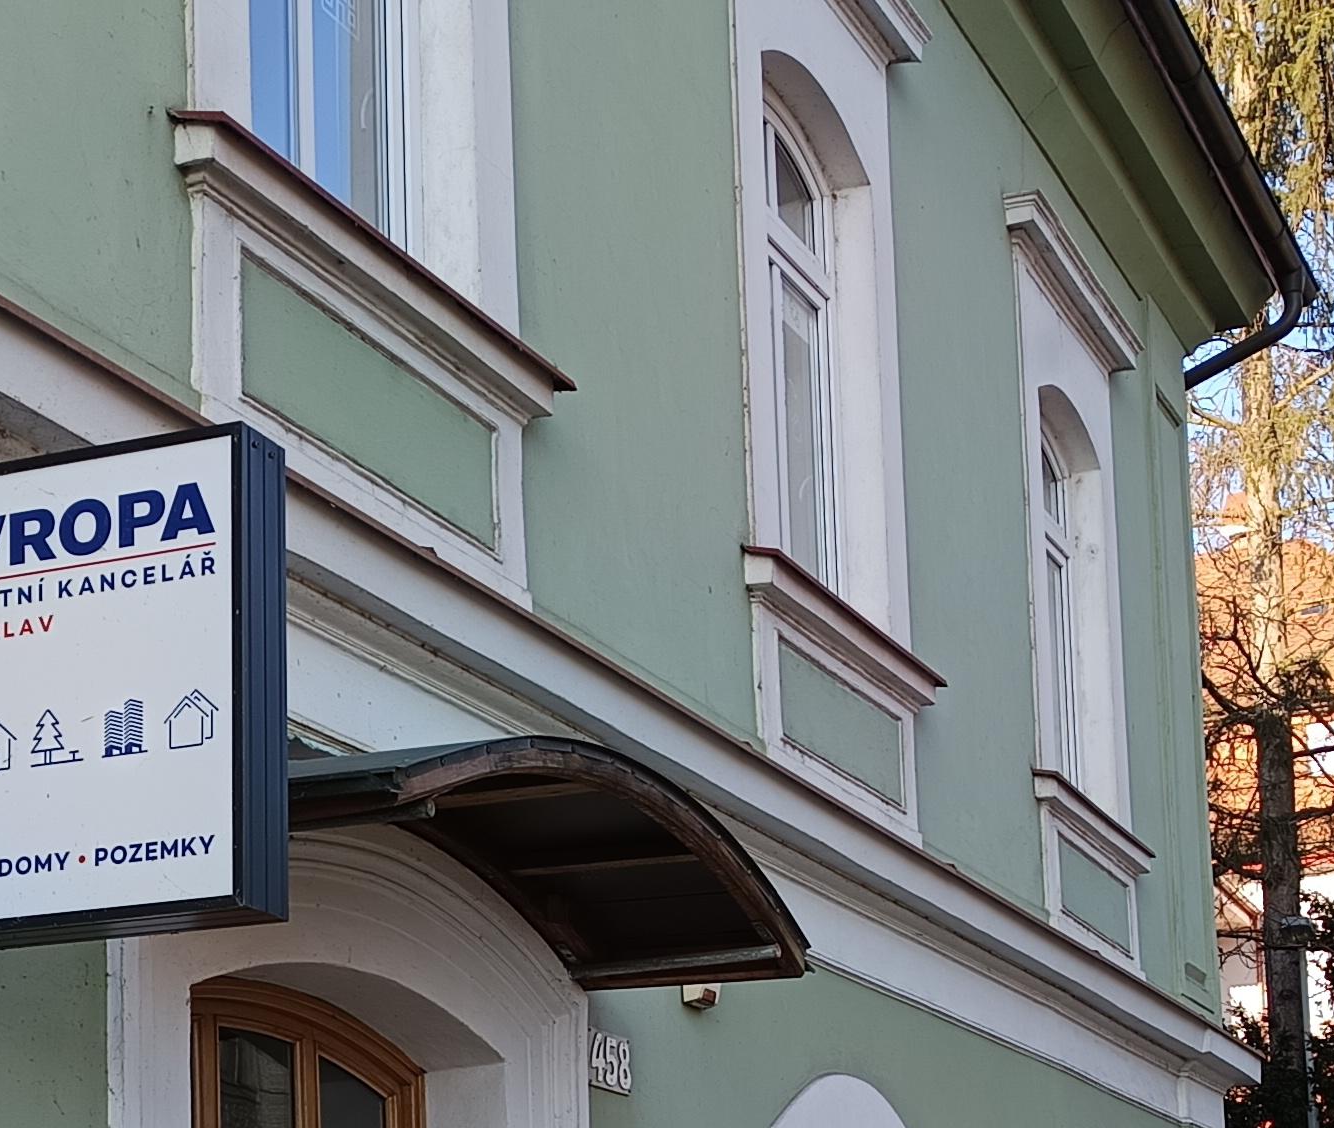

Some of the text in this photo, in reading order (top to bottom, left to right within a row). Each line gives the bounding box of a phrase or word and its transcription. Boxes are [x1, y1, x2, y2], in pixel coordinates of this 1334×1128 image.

[58, 550, 216, 599] KANCELÁŘ
[94, 834, 215, 867] POZEMKY
[590, 1032, 632, 1090] 458
